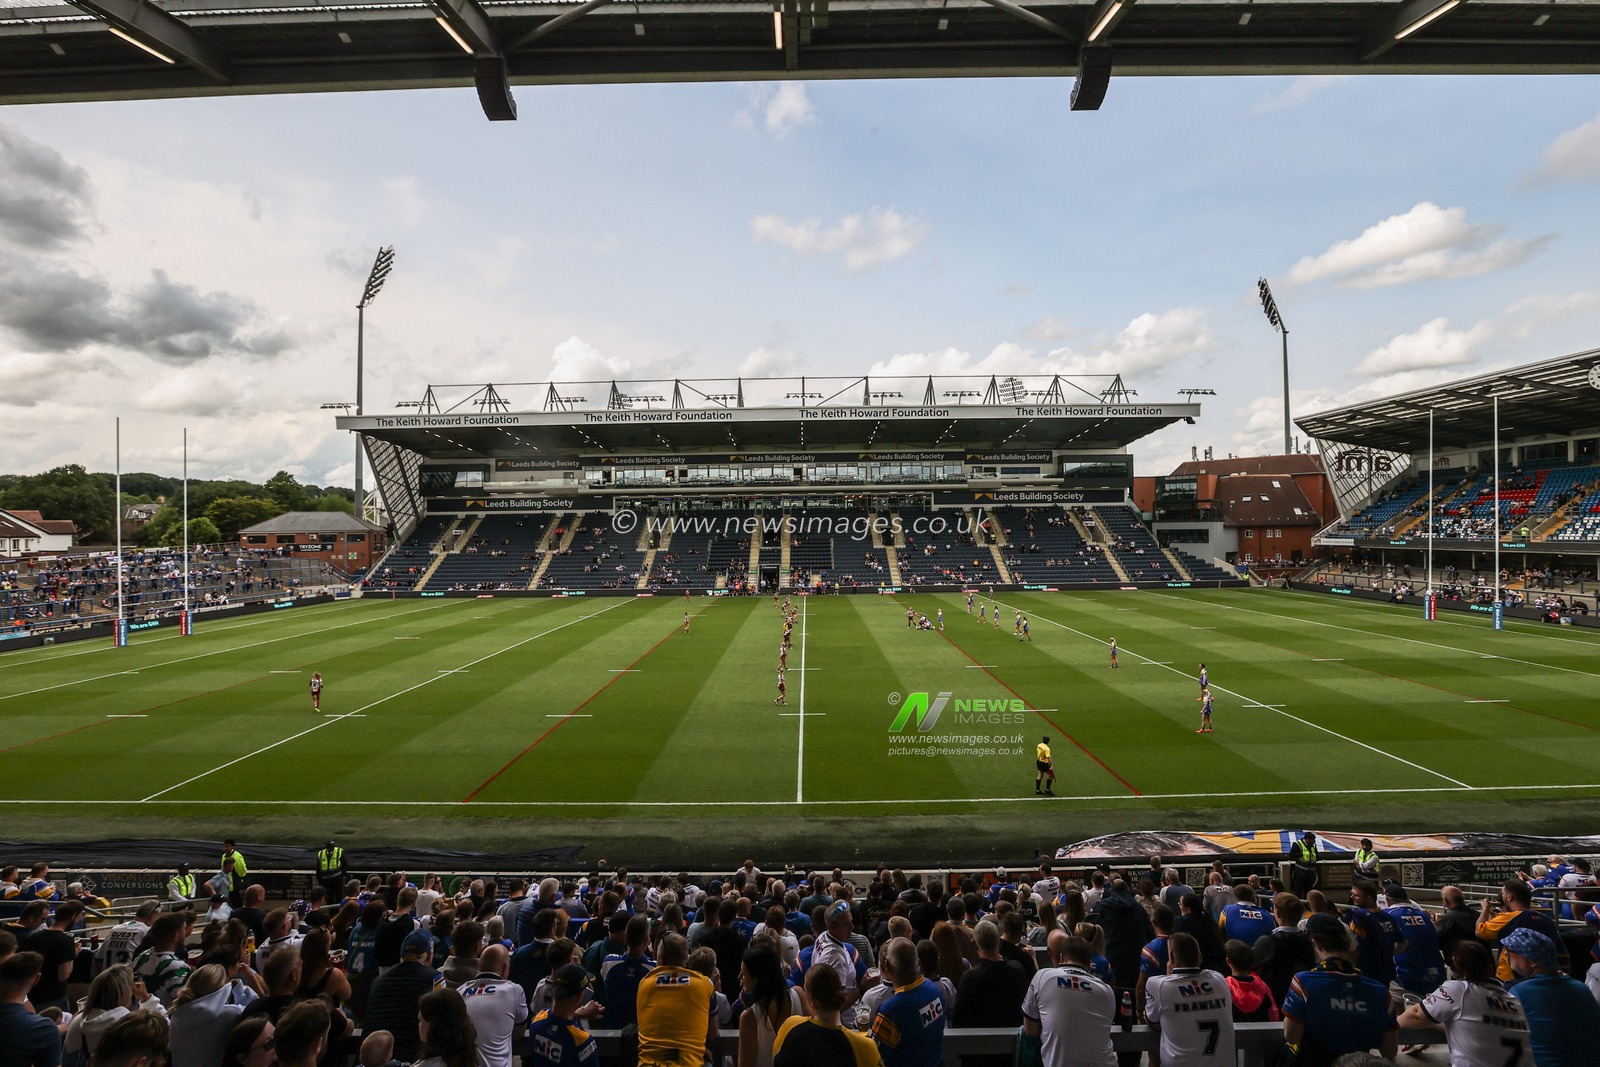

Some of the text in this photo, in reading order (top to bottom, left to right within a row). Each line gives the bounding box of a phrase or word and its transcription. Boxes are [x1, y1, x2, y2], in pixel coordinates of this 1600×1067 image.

[584, 411, 732, 422] The Keith Howard Foundation
[799, 408, 949, 418] The Keith Howard Foundation
[1016, 406, 1162, 416] The Keith Howard Foundation
[376, 415, 518, 426] The Keith Howard Foundation
[994, 492, 1084, 502] Leeds Building Society
[510, 499, 541, 509] Building
[542, 499, 573, 508] Society
[1240, 910, 1262, 919] NiC
[352, 952, 365, 972] 4
[1174, 998, 1226, 1012] FRAWLEY
[1197, 1019, 1219, 1056] 7
[1502, 1038, 1522, 1067] 7
